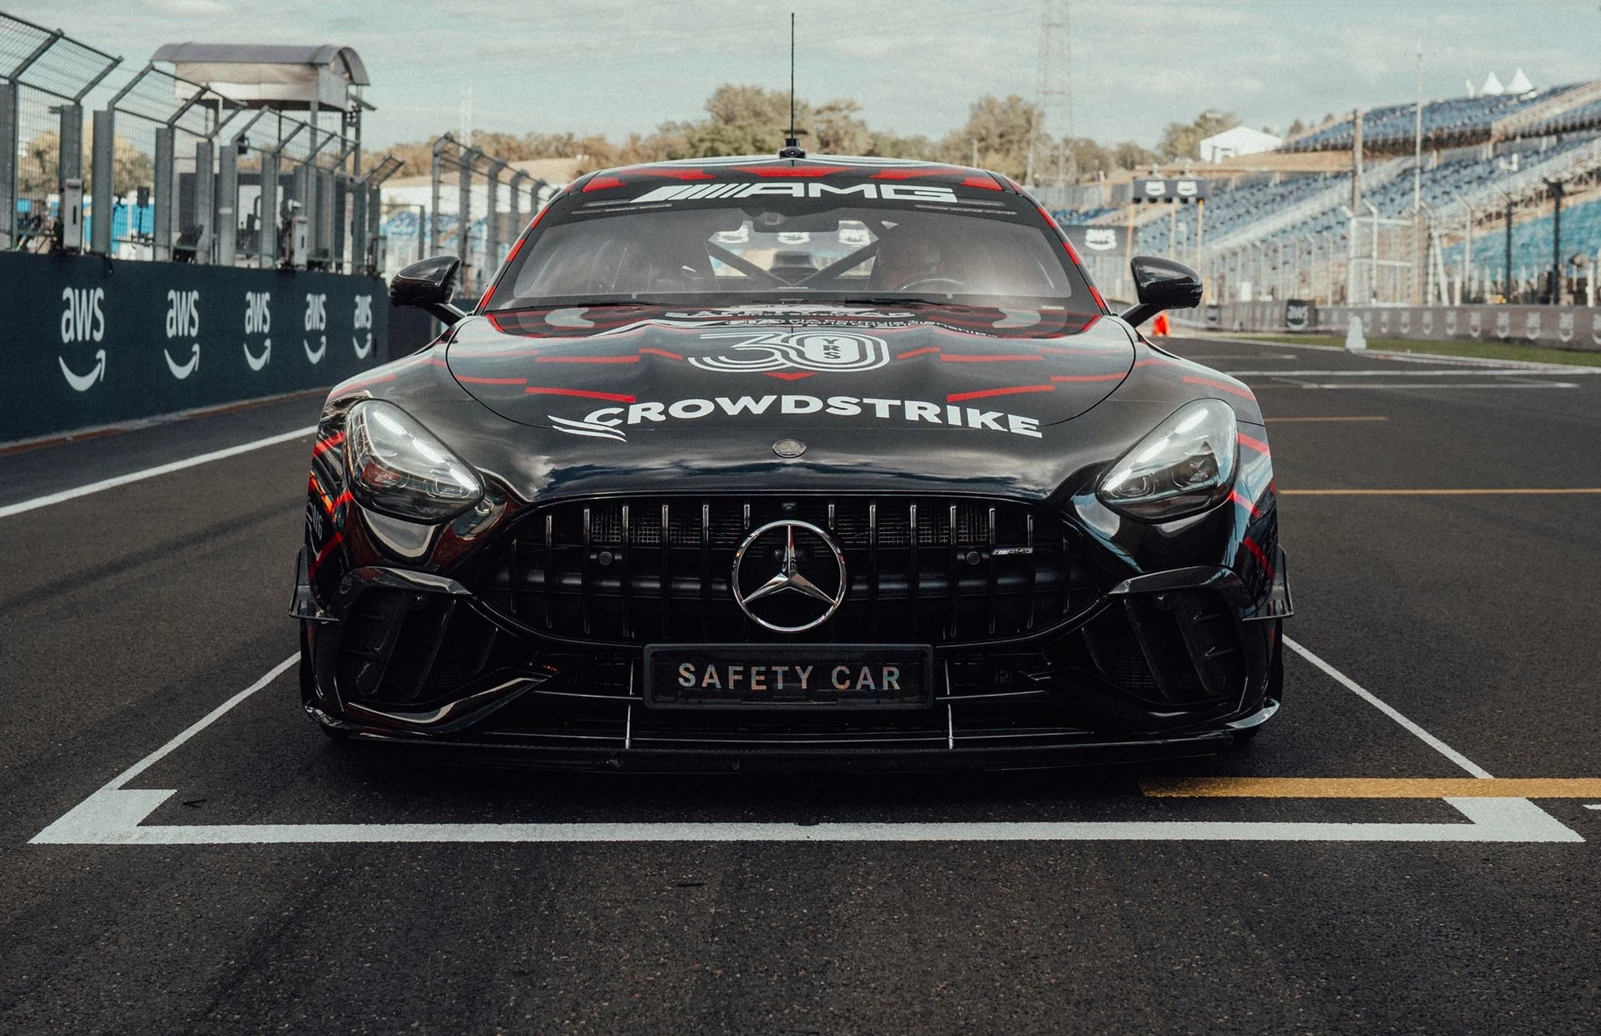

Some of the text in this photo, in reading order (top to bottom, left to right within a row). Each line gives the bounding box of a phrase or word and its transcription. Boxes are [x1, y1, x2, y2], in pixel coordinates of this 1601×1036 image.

[737, 182, 957, 204] AMG
[61, 287, 104, 343] aws
[166, 290, 199, 338] aws
[245, 291, 270, 334] aws
[305, 293, 326, 331] aws
[584, 394, 1043, 440] CROWDSTRIKE
[679, 663, 900, 690] SAFETY CAR
